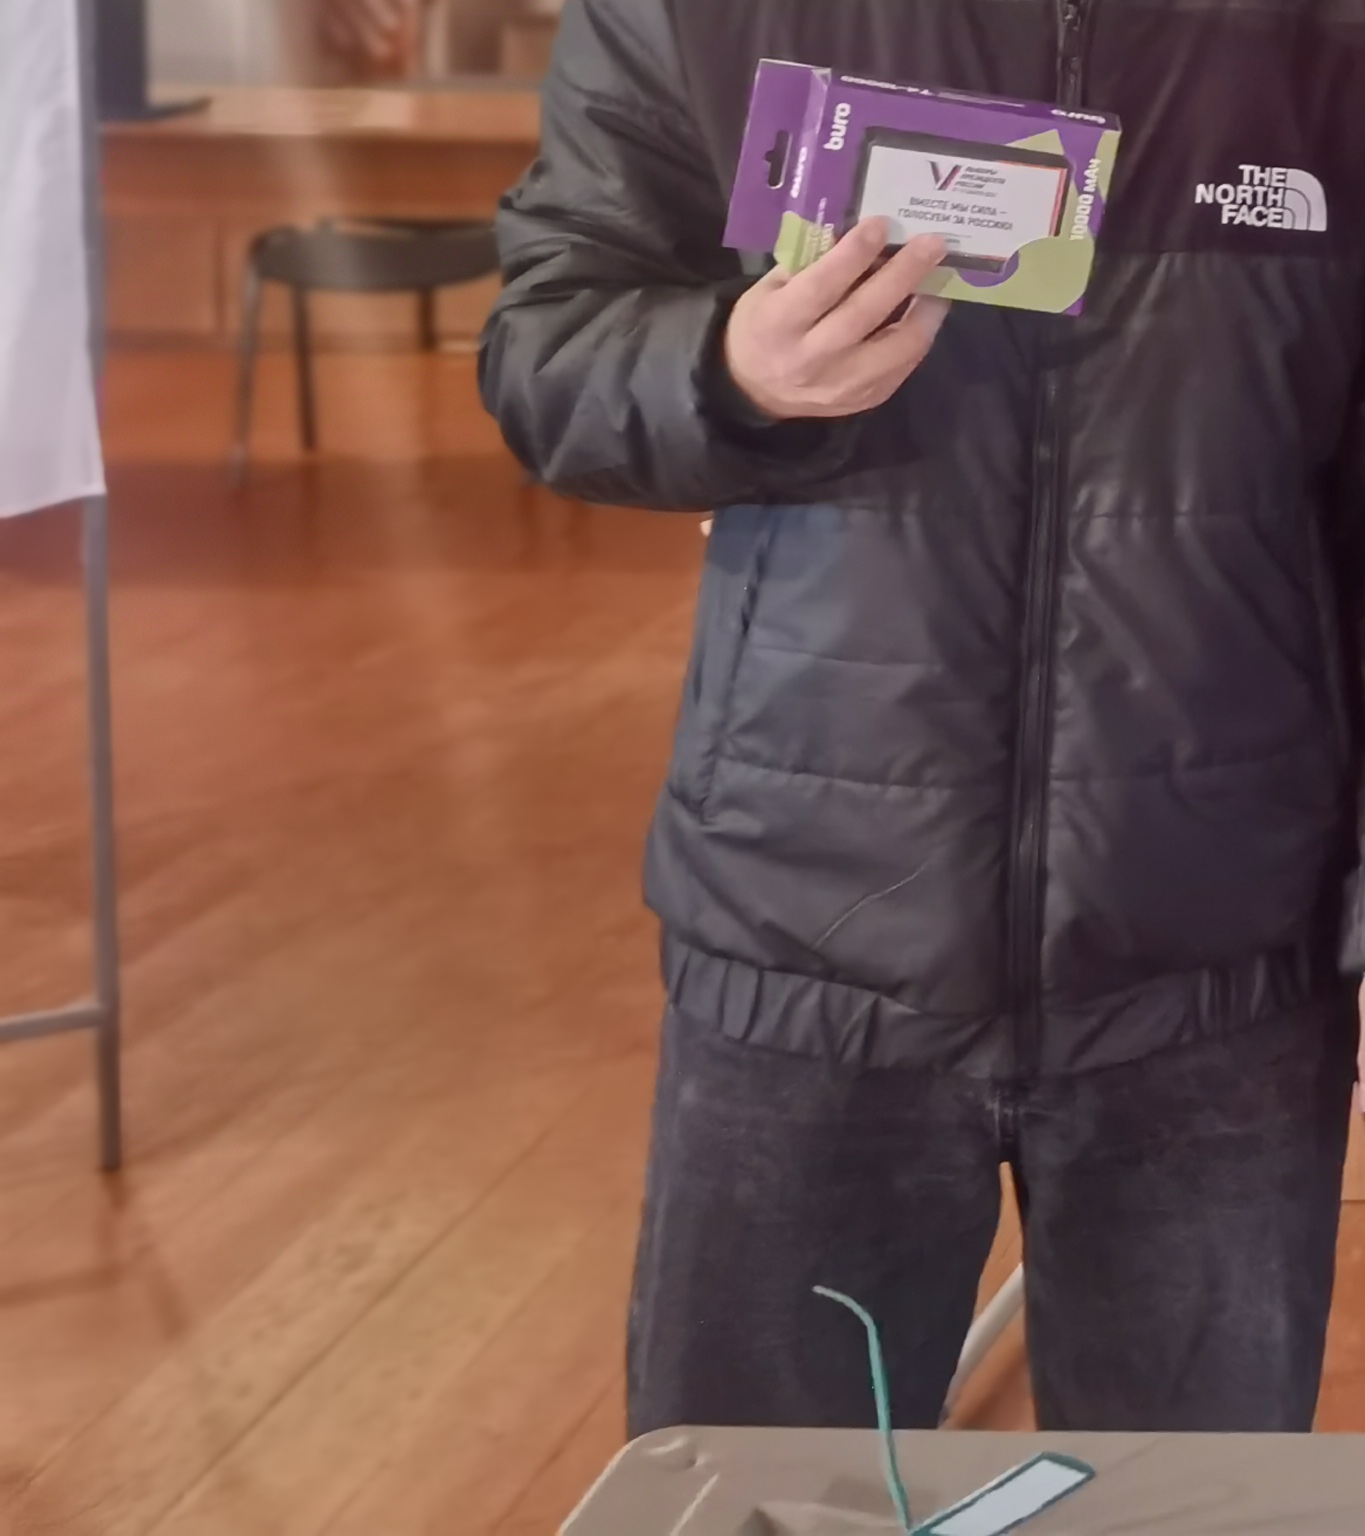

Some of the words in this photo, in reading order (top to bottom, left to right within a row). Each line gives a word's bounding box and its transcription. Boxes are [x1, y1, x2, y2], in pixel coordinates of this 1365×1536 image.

[823, 102, 851, 151] buro
[1238, 164, 1287, 187] THE
[1195, 183, 1284, 207] NORTH
[1069, 193, 1095, 241] 10000
[1221, 204, 1283, 228] FACE
